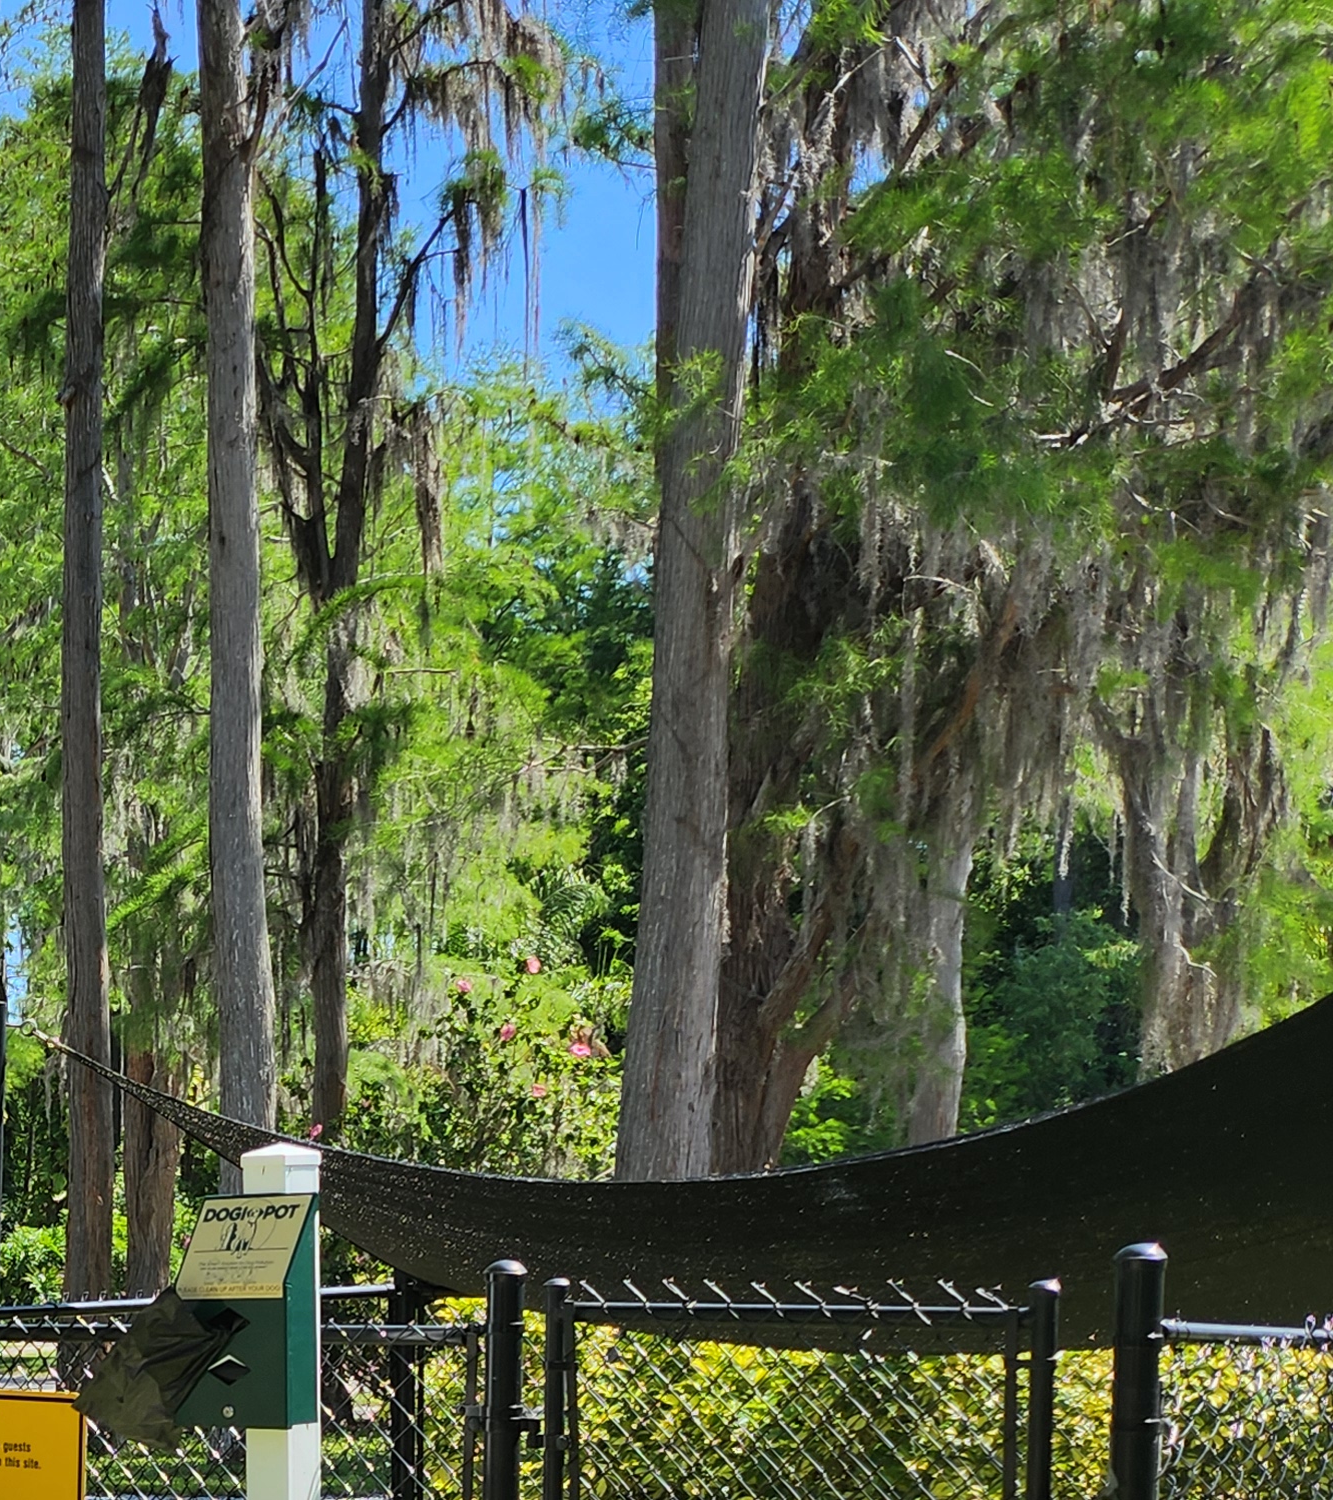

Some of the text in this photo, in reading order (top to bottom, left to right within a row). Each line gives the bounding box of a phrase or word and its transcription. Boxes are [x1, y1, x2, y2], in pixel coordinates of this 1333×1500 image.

[3, 1442, 31, 1453] guests
[5, 1457, 20, 1468] this
[23, 1458, 41, 1470] site.
